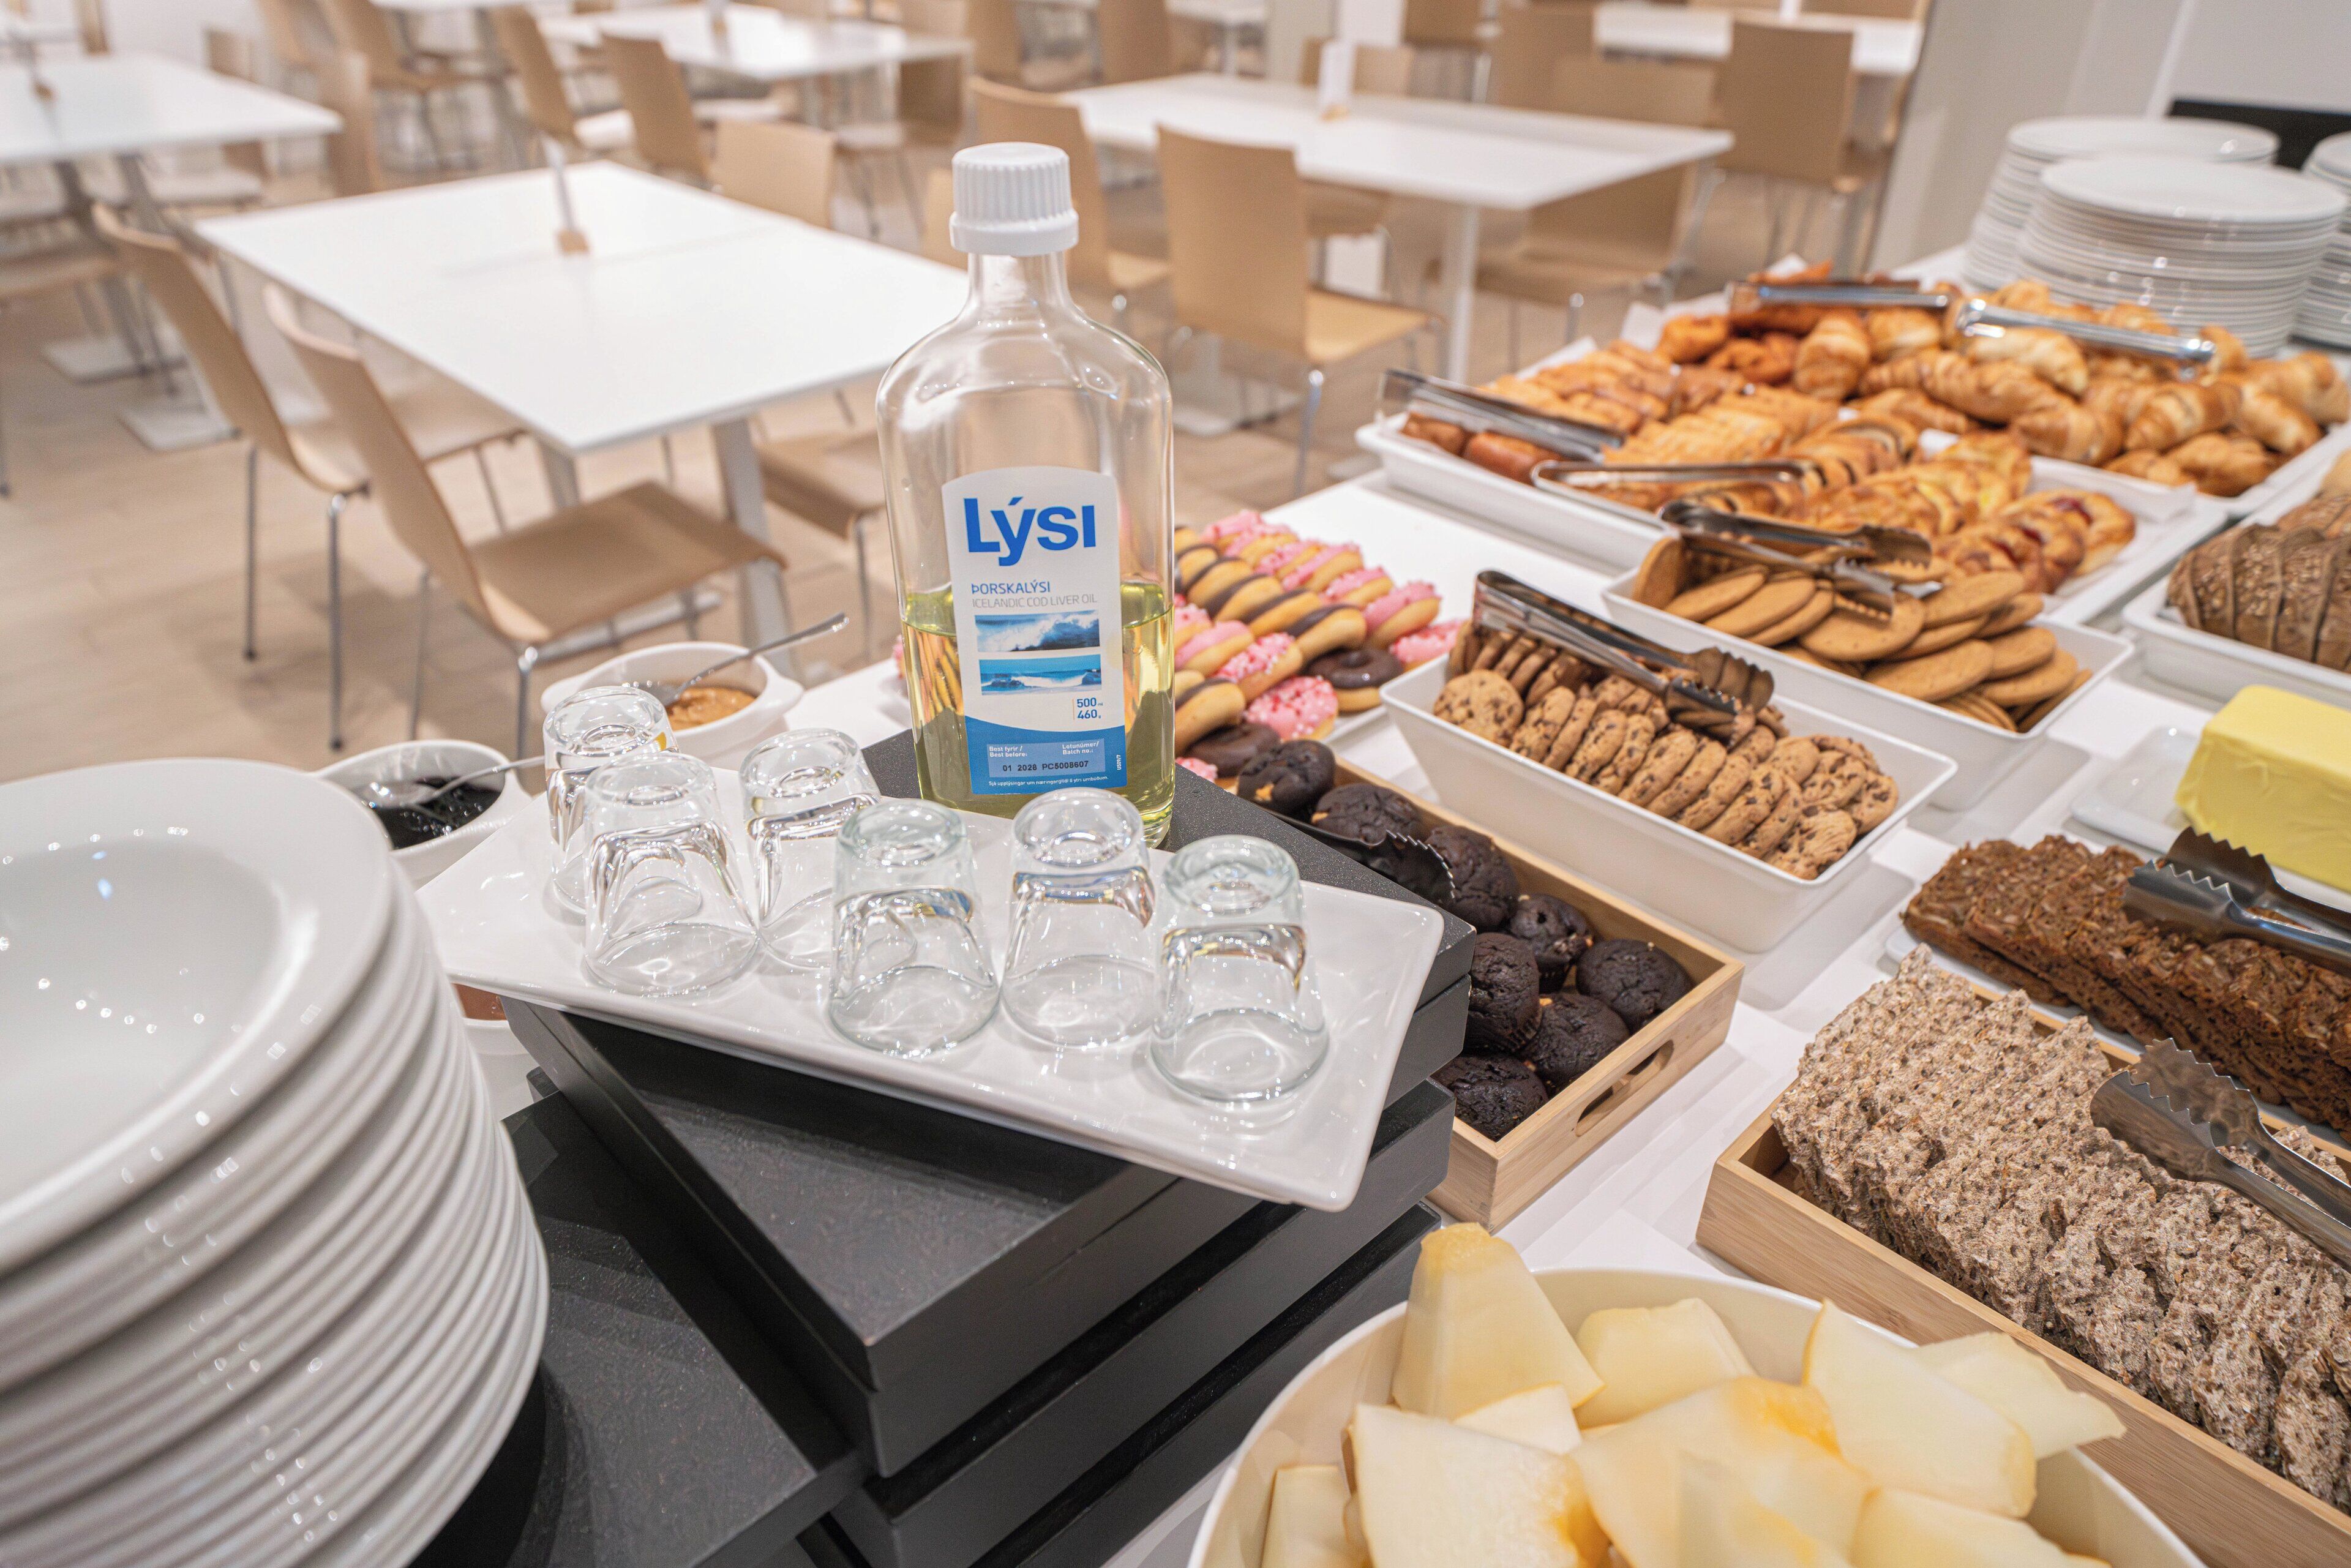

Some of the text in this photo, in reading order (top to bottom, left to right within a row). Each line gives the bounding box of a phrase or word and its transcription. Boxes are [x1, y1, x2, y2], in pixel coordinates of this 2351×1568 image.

[971, 579, 1051, 595] ÞORSKALÝSI
[972, 593, 1097, 608] ICELANDIC COD LIVER OIL
[1077, 697, 1097, 708] 500
[1077, 709, 1098, 719] 460
[1042, 760, 1089, 770] PC5008607
